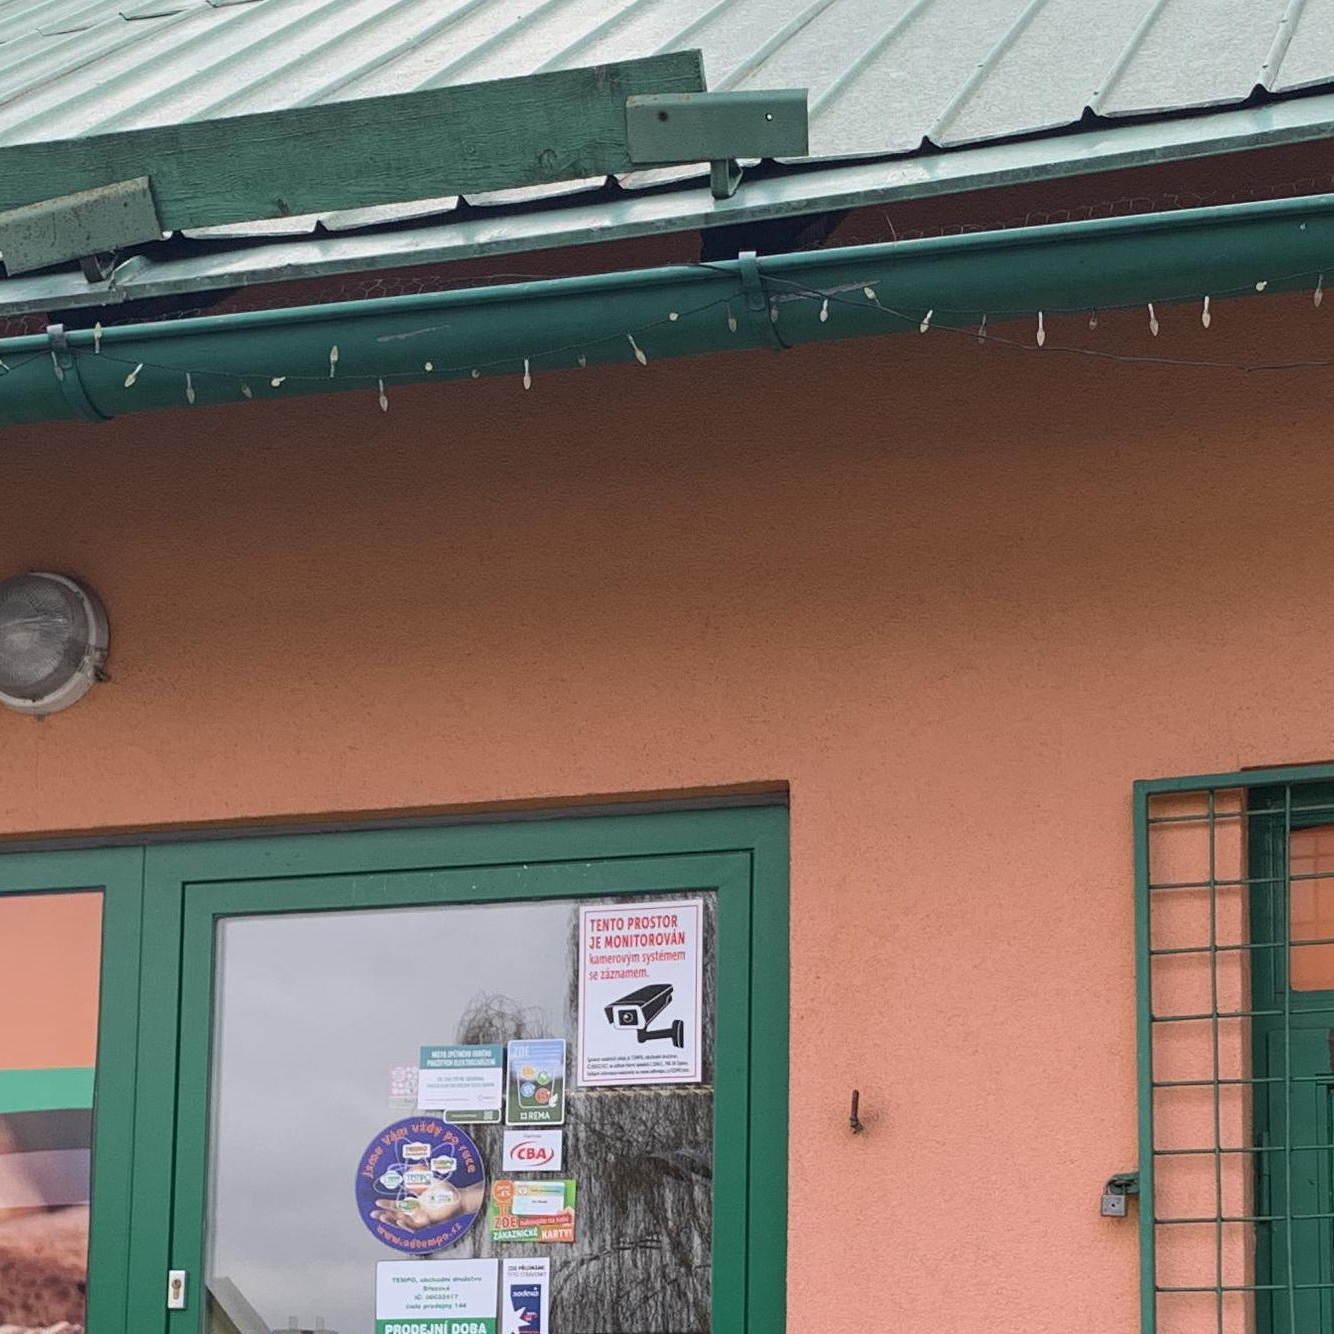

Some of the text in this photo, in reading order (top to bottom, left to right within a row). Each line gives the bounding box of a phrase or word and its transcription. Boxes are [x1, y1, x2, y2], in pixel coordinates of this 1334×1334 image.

[590, 914, 678, 932] TENTO PROSTOR
[589, 928, 686, 949] JE MONITOROVÁN
[589, 949, 686, 966] kamerovým systémem
[589, 970, 598, 980] se
[528, 1111, 551, 1120] REMA
[517, 1148, 547, 1160] CBA
[494, 1216, 517, 1229] ZDE
[451, 1322, 487, 1334] DOBA
